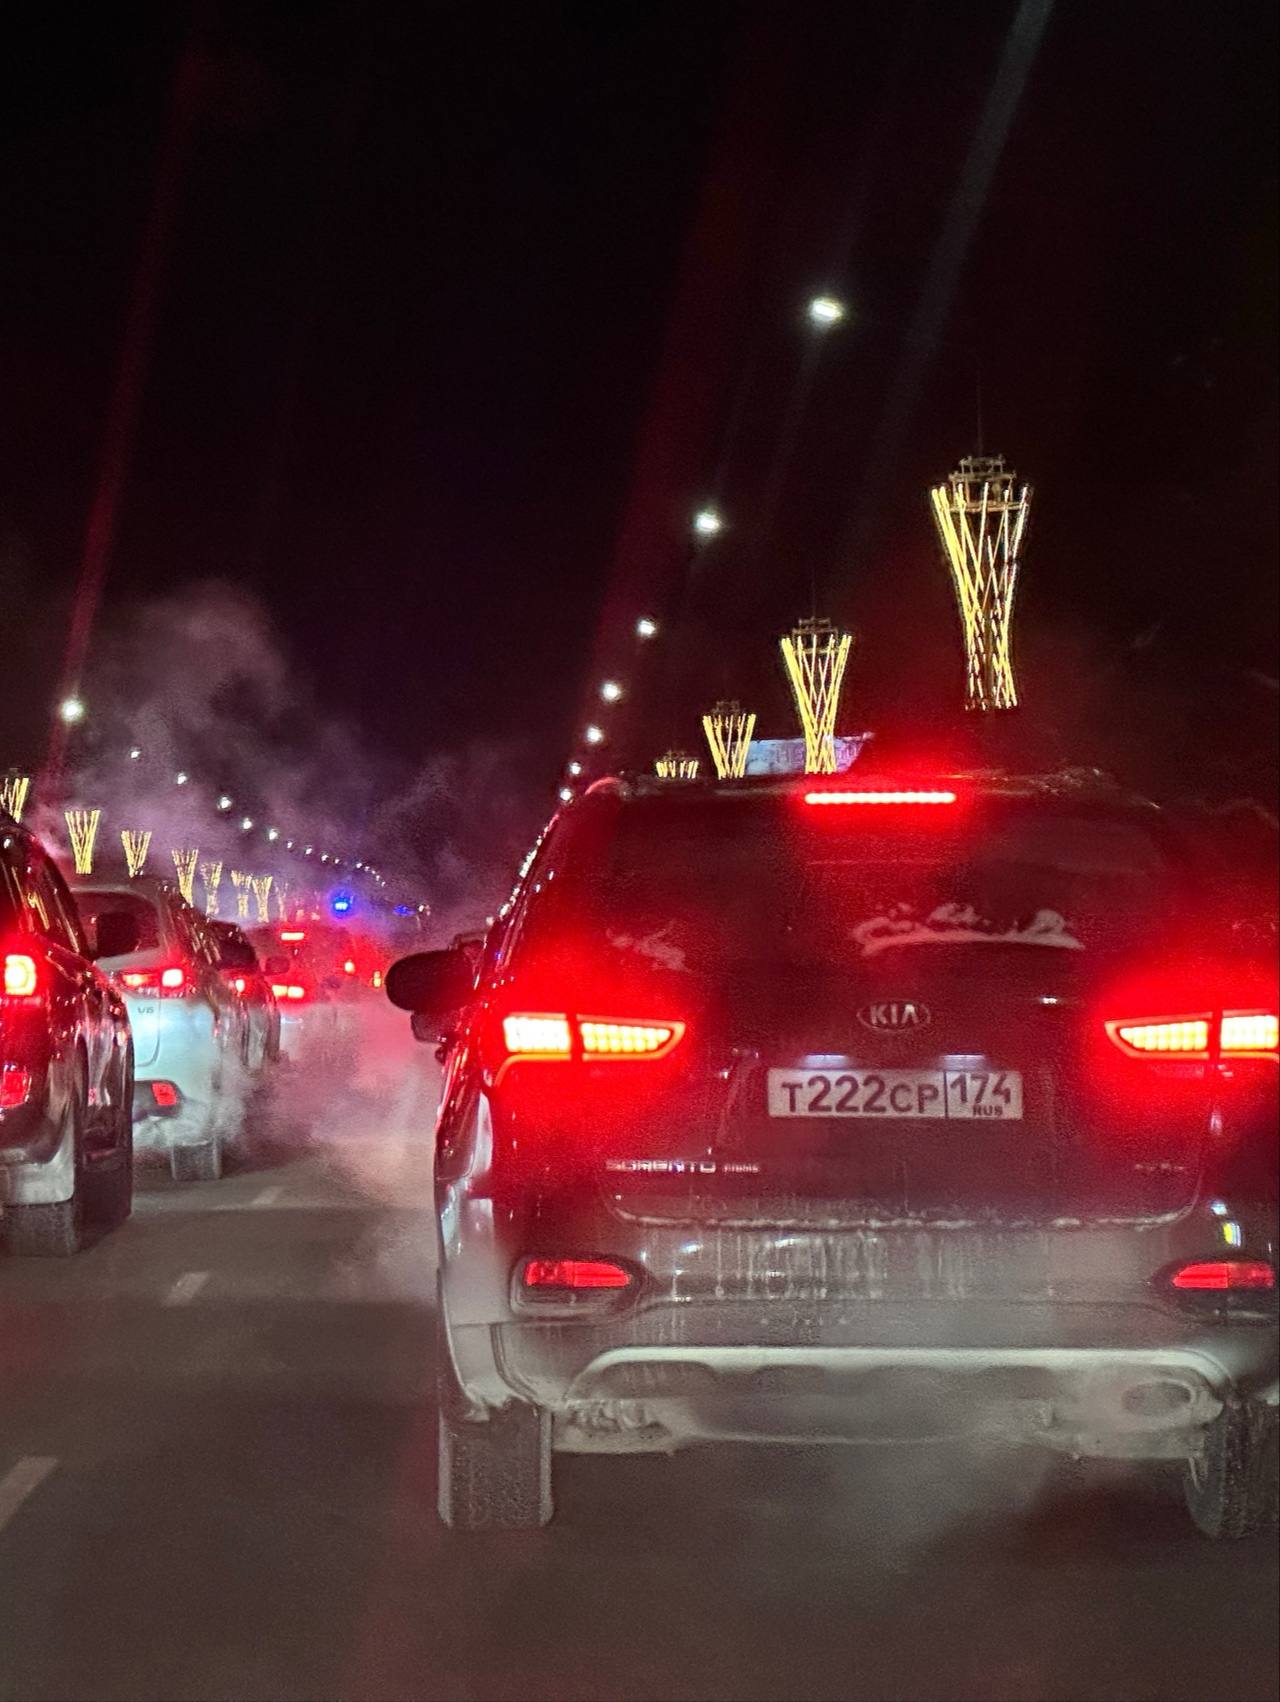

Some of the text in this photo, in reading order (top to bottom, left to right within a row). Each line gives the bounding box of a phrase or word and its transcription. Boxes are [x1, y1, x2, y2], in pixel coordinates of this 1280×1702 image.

[871, 1003, 919, 1025] KIA
[781, 1072, 1012, 1114] T222CP 174
[972, 1104, 1004, 1117] RUS
